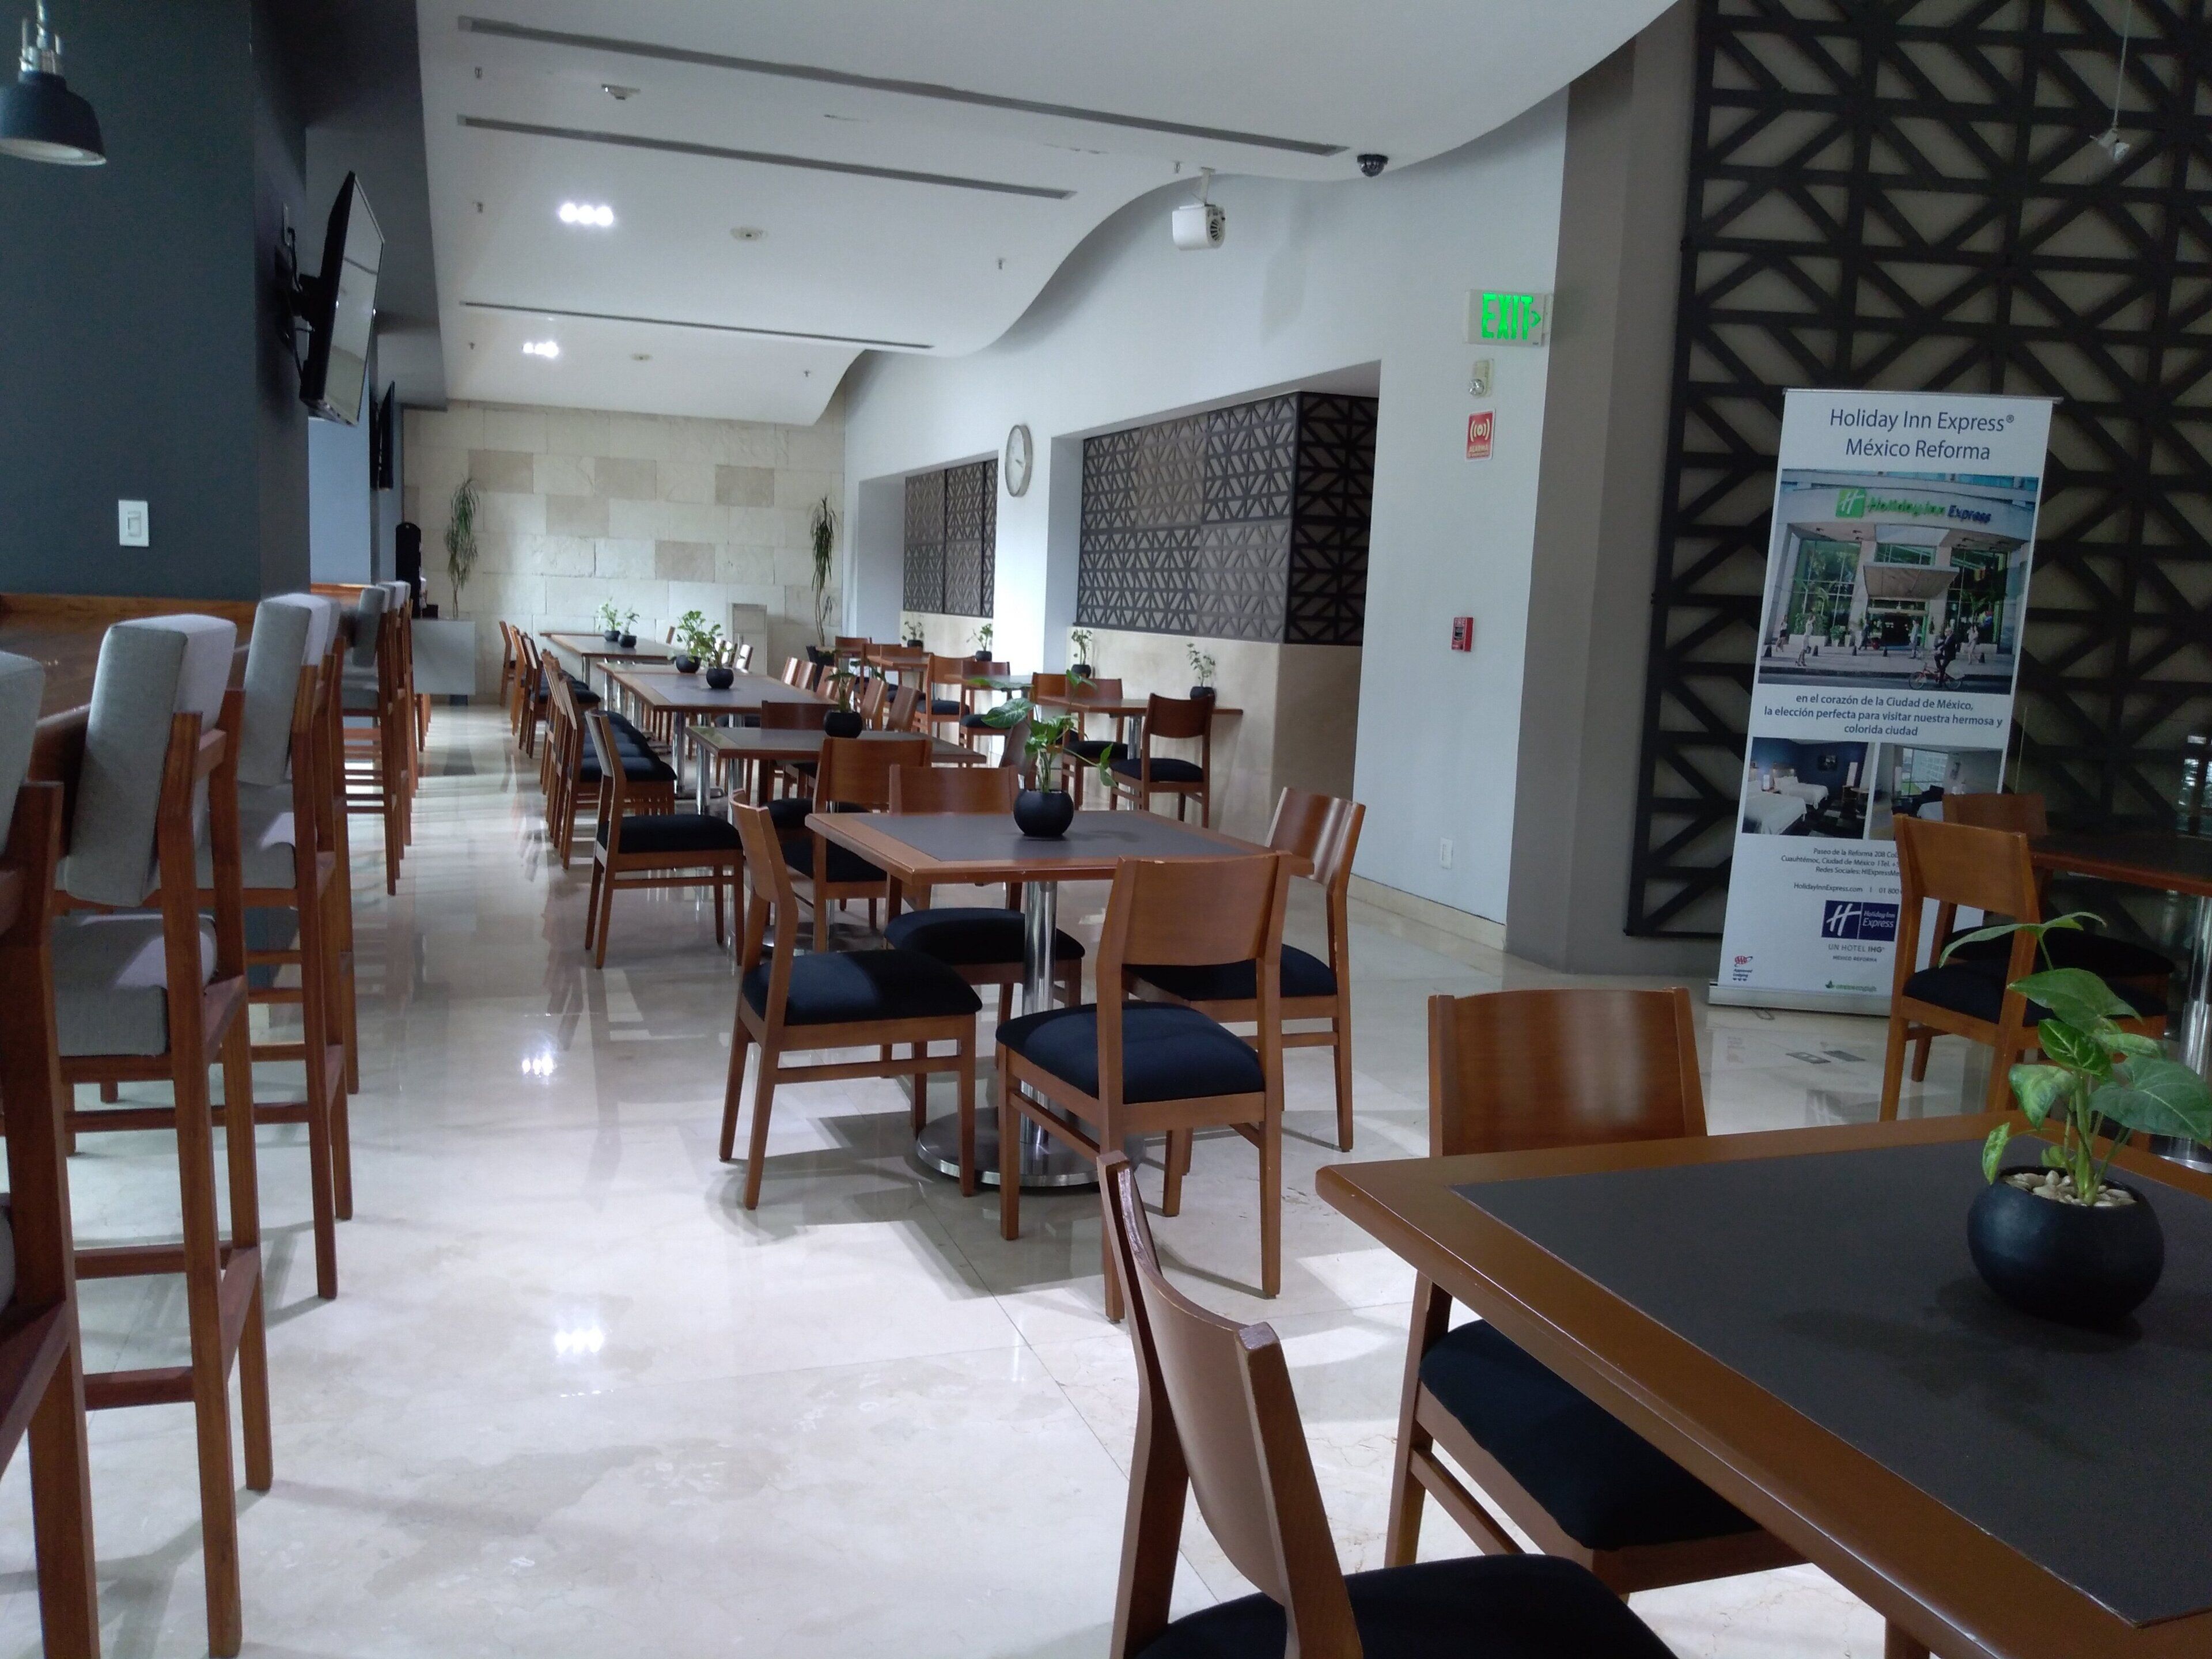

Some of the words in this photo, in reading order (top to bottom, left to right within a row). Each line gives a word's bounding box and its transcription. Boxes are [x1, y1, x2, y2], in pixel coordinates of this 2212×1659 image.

[1482, 293, 1533, 340] EXIT
[1830, 408, 1898, 432] Holiday
[1904, 411, 1931, 429] Inn
[1846, 438, 1910, 457] México
[1915, 440, 1990, 460] Reforma
[1948, 505, 1992, 524] Express
[1796, 695, 1808, 703] en
[1810, 694, 1819, 703] el
[1821, 695, 1858, 704] corazón
[1861, 696, 1873, 705] de
[1876, 696, 1884, 706] la
[1887, 697, 1920, 707] Ciudad
[1923, 698, 1934, 708] de
[1937, 699, 1973, 711] México,
[1764, 706, 1772, 715] la
[1775, 706, 1813, 717] elección
[1816, 709, 1855, 719] perfecta
[1858, 712, 1880, 721] para
[1883, 711, 1911, 721] visitar
[1914, 714, 1949, 724] nuestra
[1952, 714, 1994, 725] hermosa
[1997, 719, 2003, 728] y
[1844, 724, 1883, 734] colorida
[1885, 725, 1918, 736] ciudad
[1862, 918, 1894, 928] Express
[1863, 911, 1885, 919] Holiday
